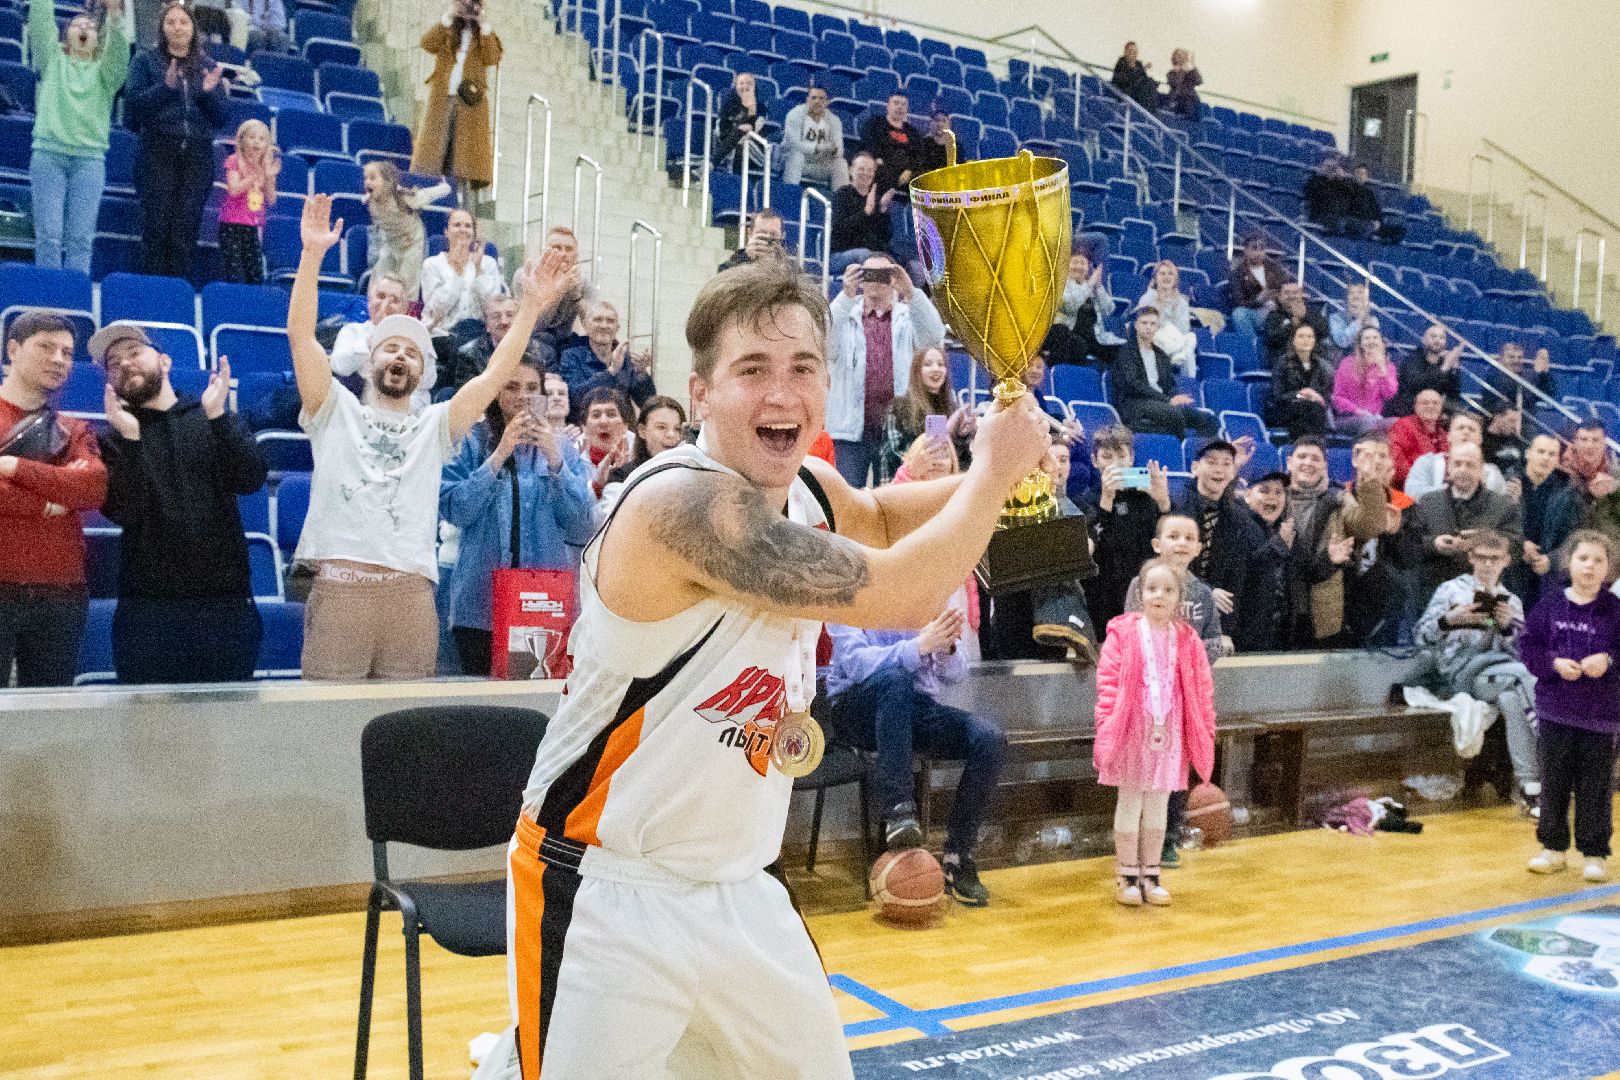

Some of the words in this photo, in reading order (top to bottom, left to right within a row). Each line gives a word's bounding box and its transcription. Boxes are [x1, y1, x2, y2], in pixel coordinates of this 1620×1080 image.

[969, 191, 1010, 203] ФИНАЛ
[718, 727, 772, 756] ЛЫТ
[1314, 1007, 1360, 1026] АО
[902, 1030, 1083, 1072] www.lzos.ru
[1100, 1017, 1313, 1073] «Лыткаринский
[1207, 1023, 1511, 1080] ЛЗО
[1016, 1063, 1100, 1080] зав
